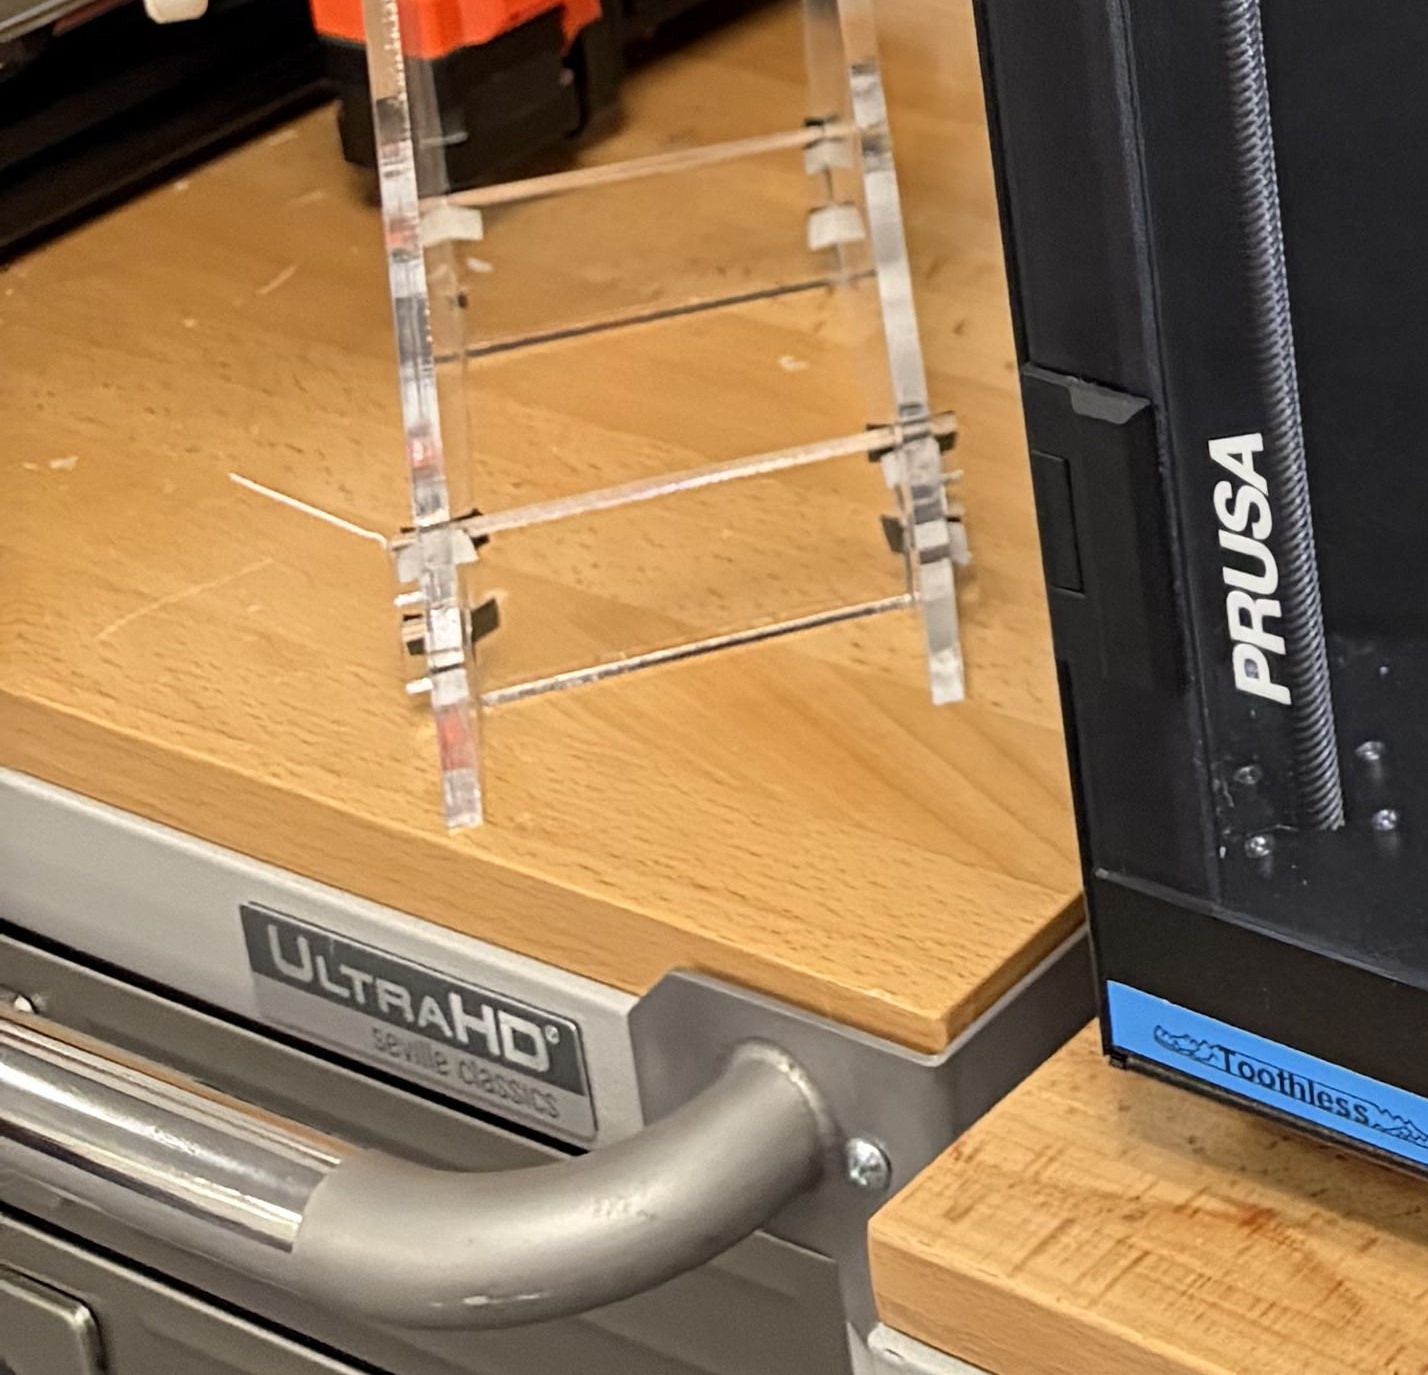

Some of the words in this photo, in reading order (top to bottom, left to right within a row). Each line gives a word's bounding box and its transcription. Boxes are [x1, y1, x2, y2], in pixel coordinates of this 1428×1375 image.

[1208, 432, 1292, 706] PRUSA
[370, 1025, 450, 1077] seville
[458, 1059, 561, 1119] classics
[1219, 1045, 1370, 1127] Toothless
